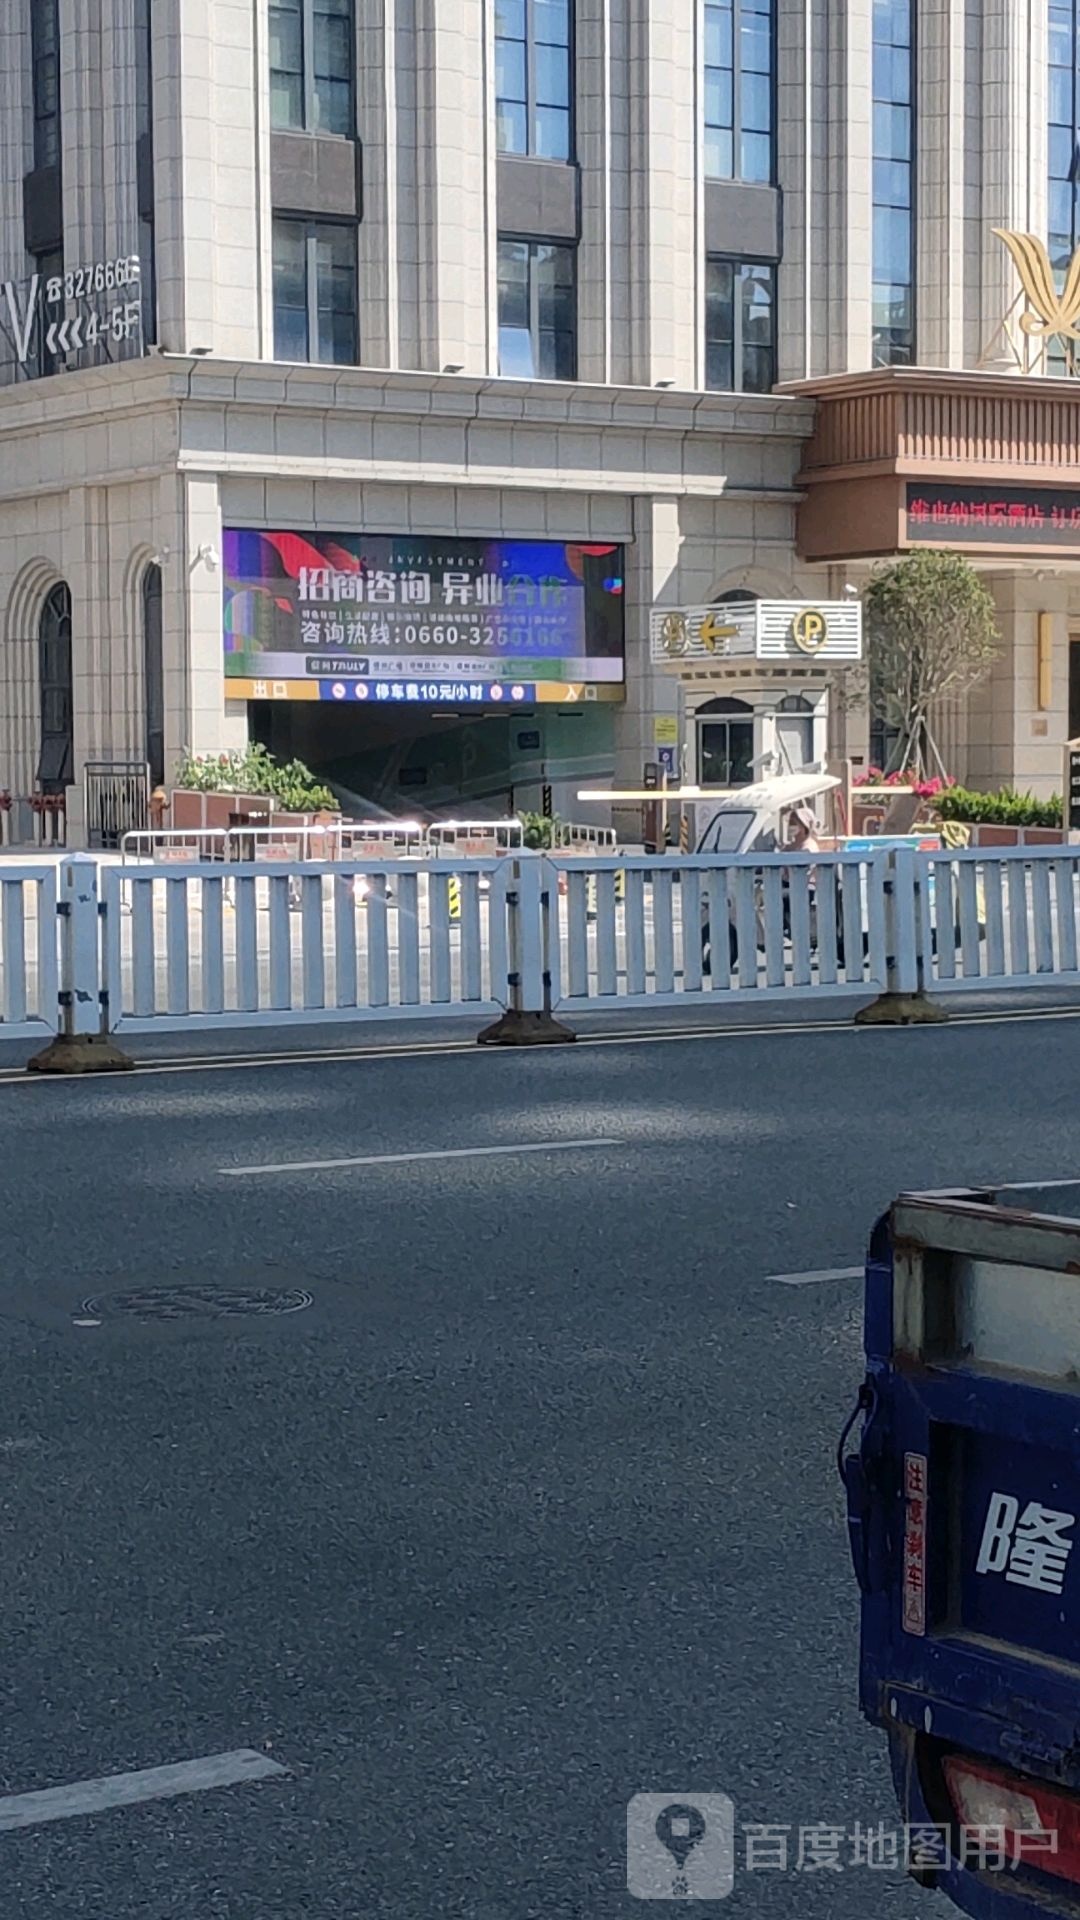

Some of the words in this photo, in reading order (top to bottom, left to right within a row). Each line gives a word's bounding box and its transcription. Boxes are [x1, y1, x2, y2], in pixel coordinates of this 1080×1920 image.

[85, 300, 140, 346] 4-5F
[298, 566, 431, 605] 招商咨询
[253, 680, 288, 699] 出口
[376, 683, 483, 700] 停车费10元/小时
[564, 684, 598, 701] 入口
[976, 1491, 1075, 1595] 隆
